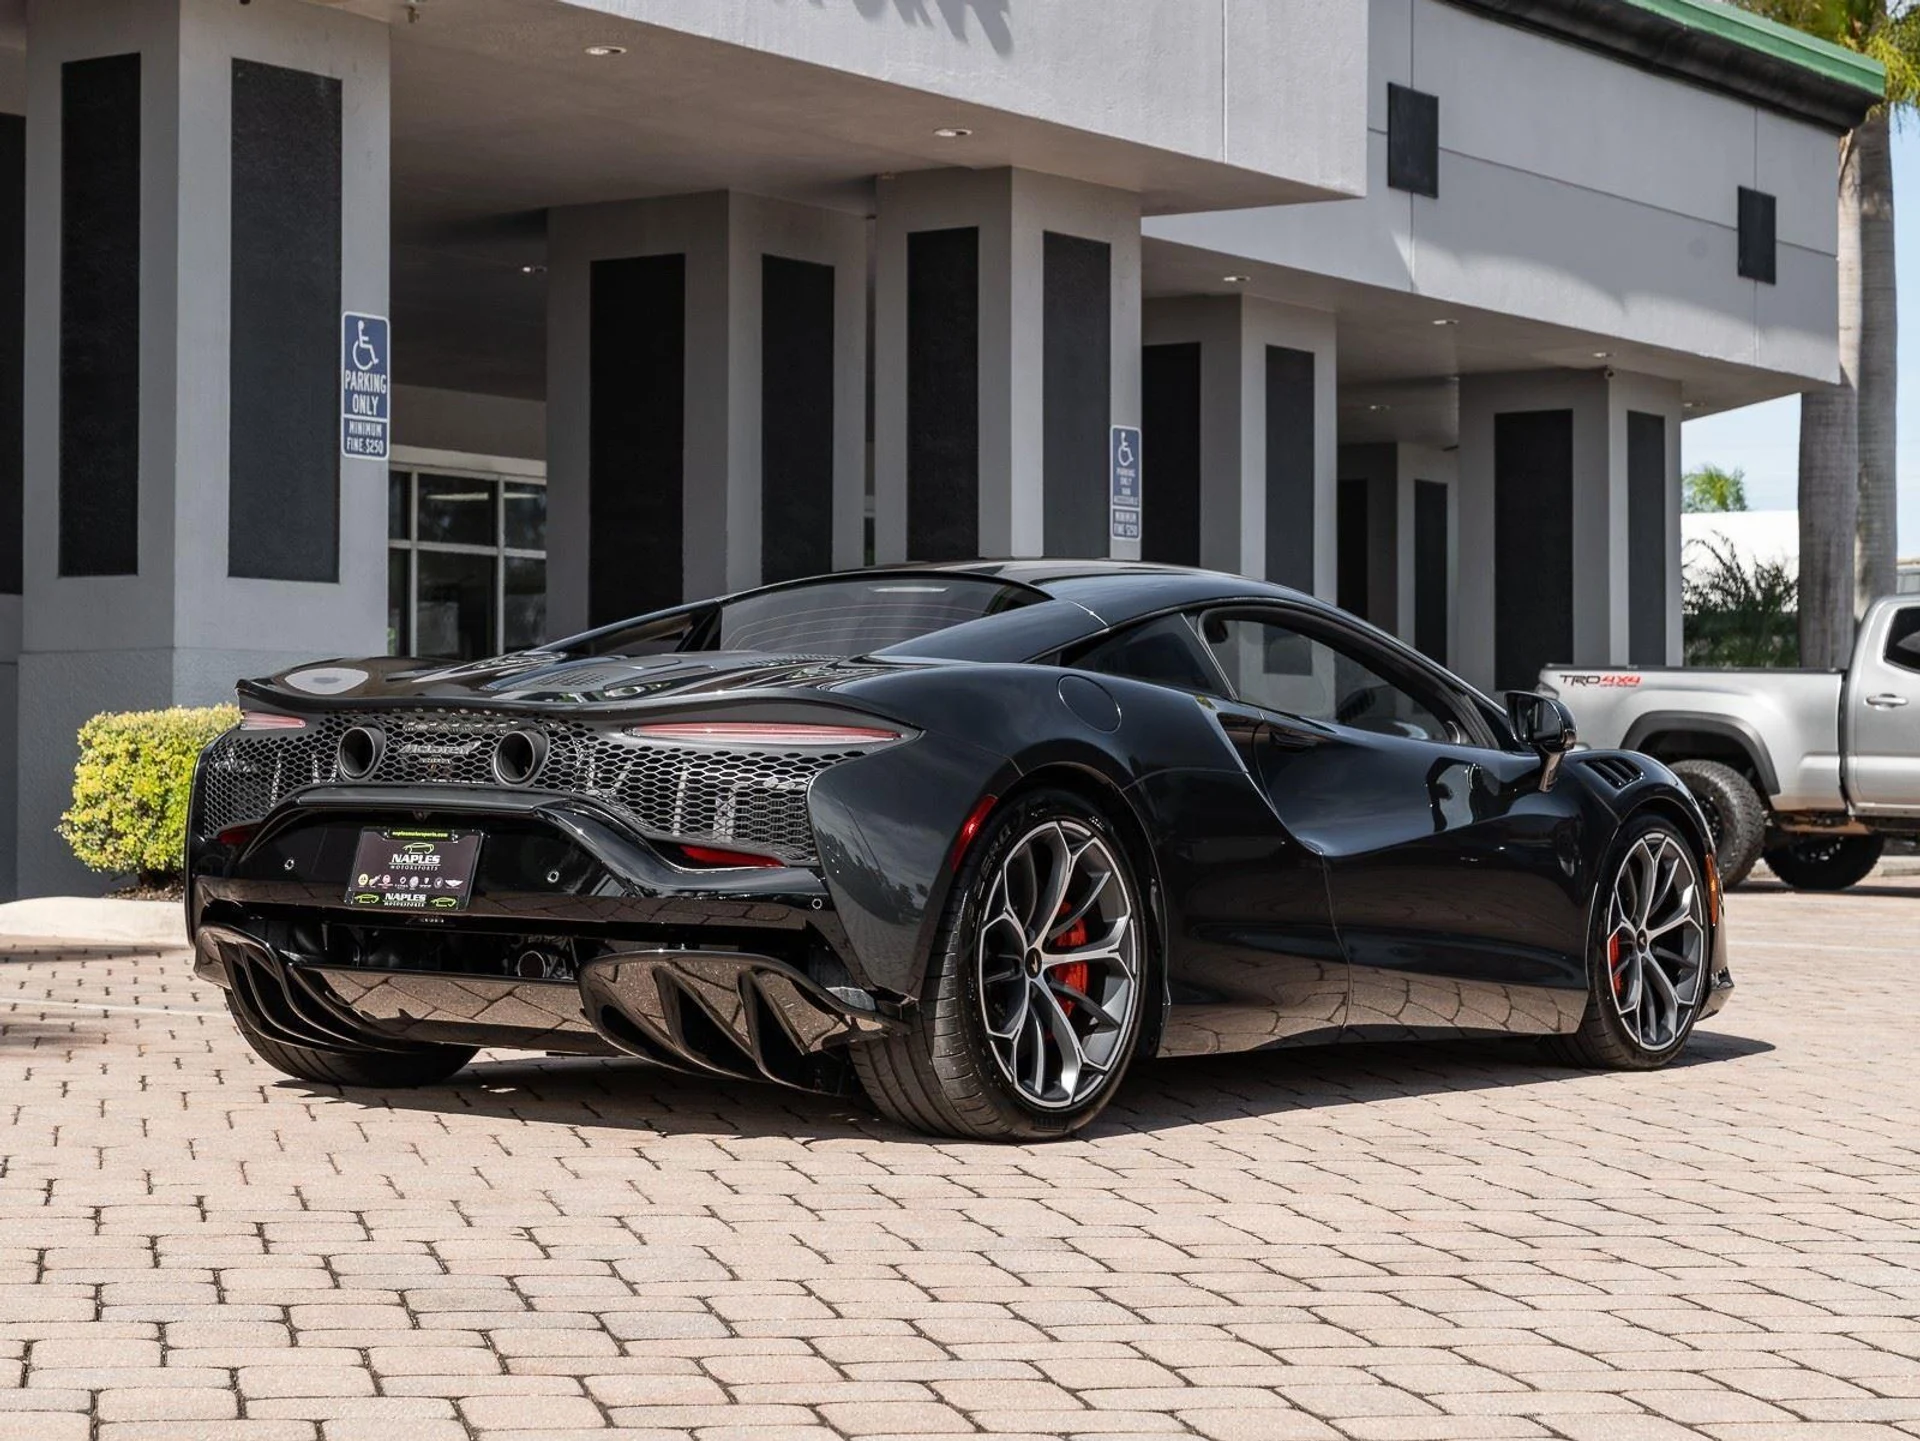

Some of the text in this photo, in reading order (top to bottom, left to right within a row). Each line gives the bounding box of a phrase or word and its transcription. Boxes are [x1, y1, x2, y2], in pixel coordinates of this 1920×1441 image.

[345, 370, 387, 394] PARKING
[352, 394, 379, 415] ONLY
[349, 421, 382, 437] MINIMUM
[346, 437, 384, 454] FINE $250
[391, 854, 441, 864] NAPLES
[384, 893, 427, 902] NAPLES
